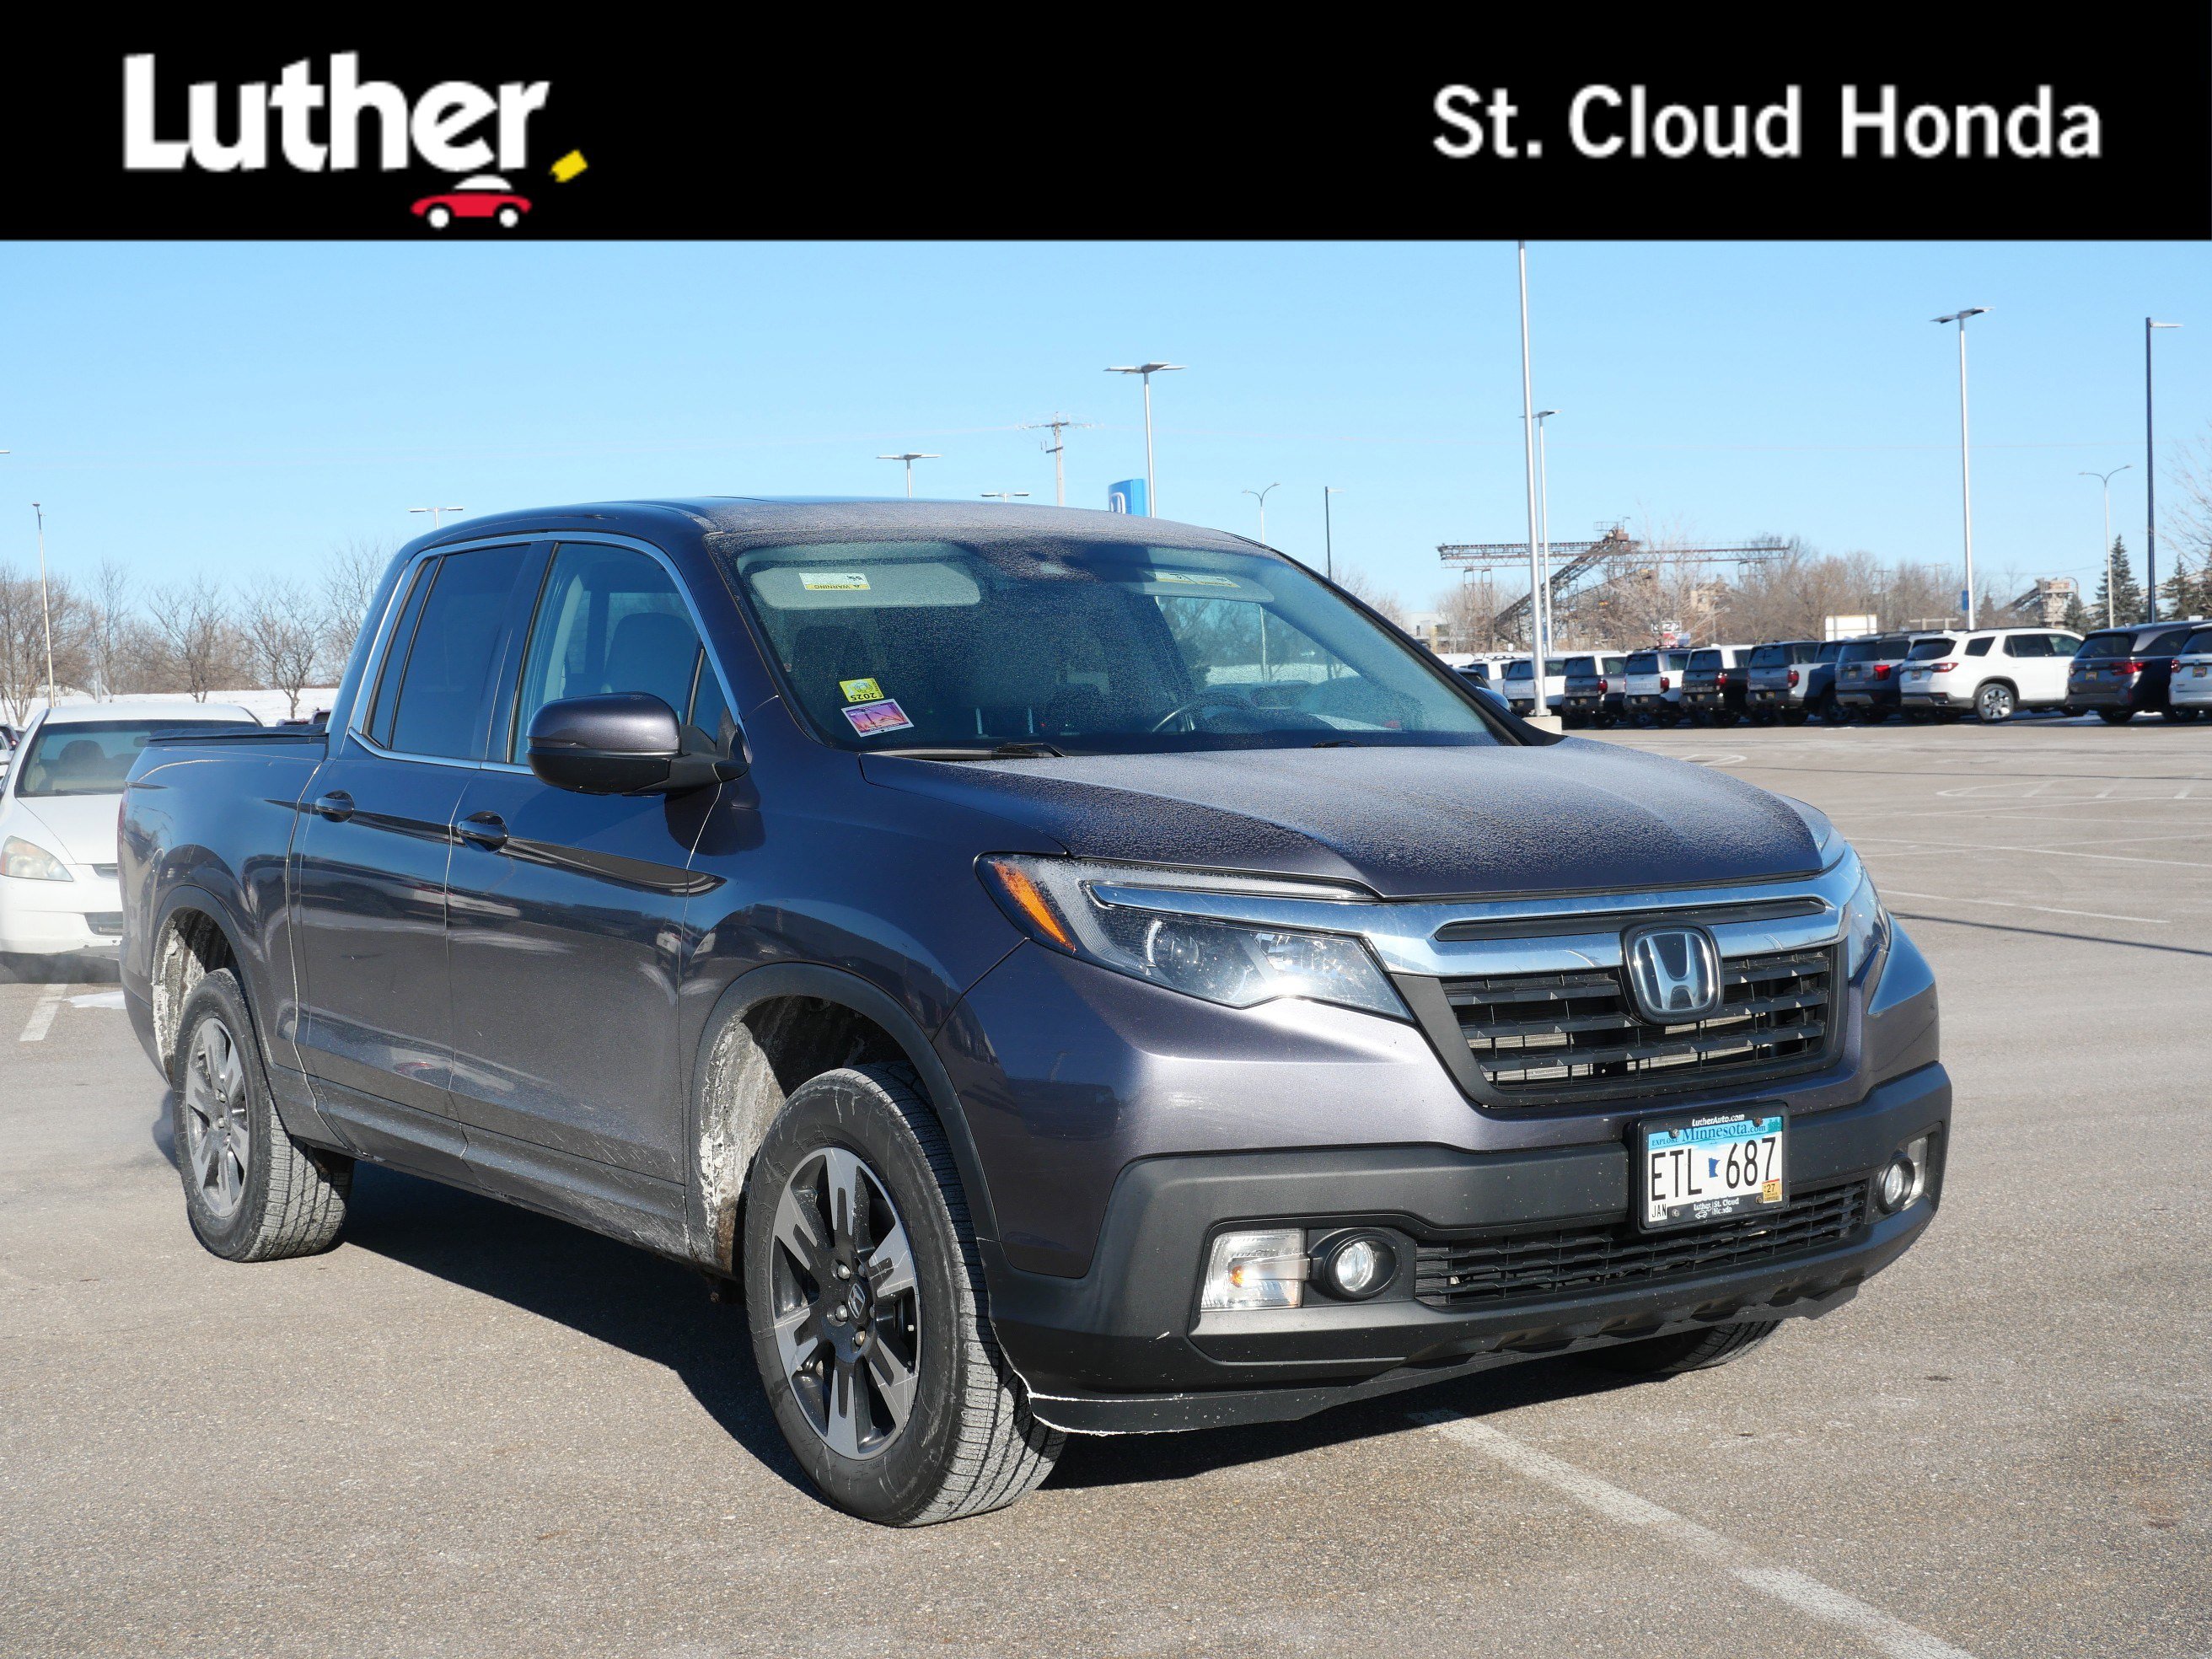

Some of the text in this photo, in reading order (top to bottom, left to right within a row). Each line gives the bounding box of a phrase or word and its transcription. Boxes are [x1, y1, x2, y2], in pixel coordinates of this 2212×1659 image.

[850, 692, 878, 701] 2025
[1692, 1114, 1746, 1127] LutherAuto.com
[1682, 1122, 1767, 1142] Minnesota.com
[1651, 1136, 1776, 1201] ETL 687
[1766, 1183, 1776, 1193] 27
[1651, 1203, 1667, 1219] JAN
